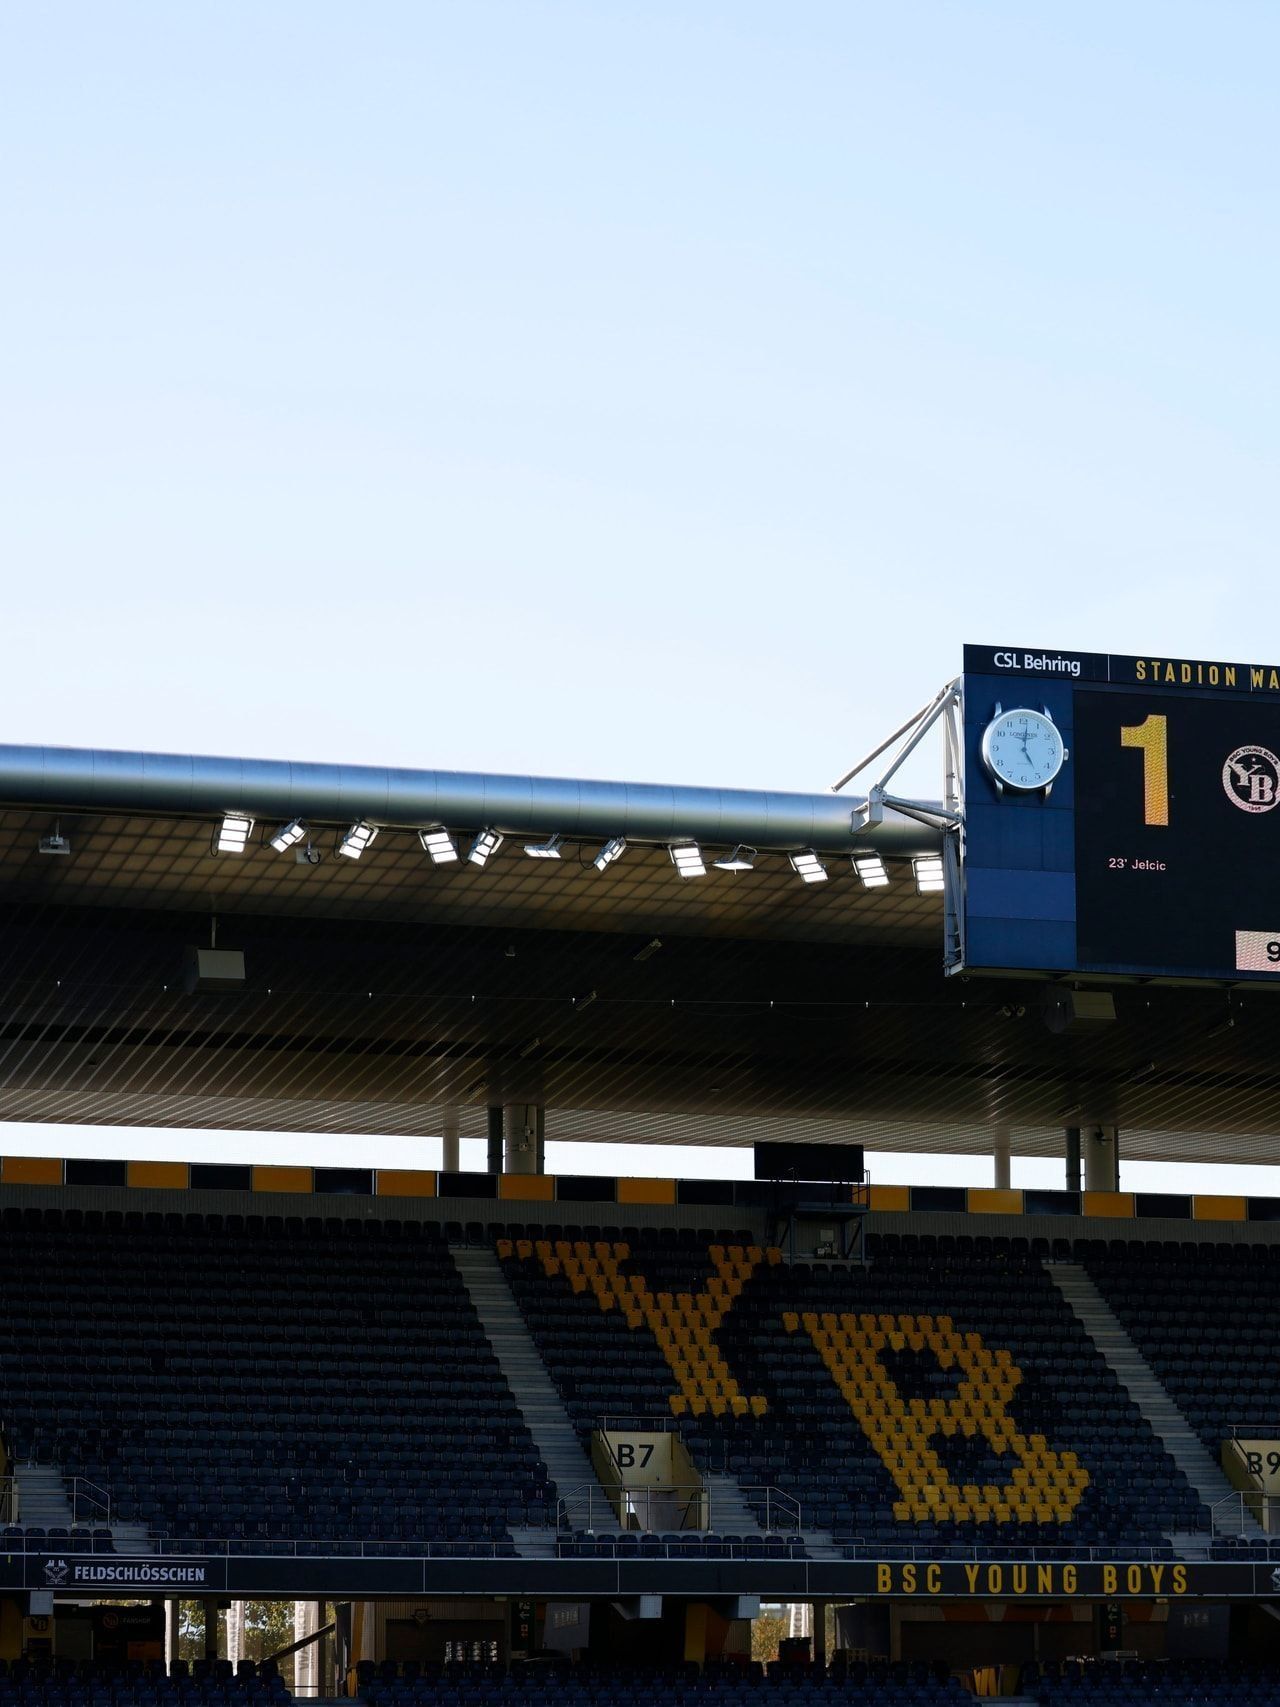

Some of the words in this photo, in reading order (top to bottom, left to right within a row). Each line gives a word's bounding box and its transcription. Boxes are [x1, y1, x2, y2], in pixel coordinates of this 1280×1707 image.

[994, 652, 1021, 669] CSL
[1024, 654, 1080, 677] Behring
[1136, 660, 1236, 687] STADION
[1121, 714, 1169, 826] 1
[1228, 762, 1274, 803] YB
[1108, 857, 1128, 869] 23'
[1131, 859, 1167, 871] Jelcic
[617, 1443, 654, 1468] B7
[1247, 1451, 1280, 1475] B9
[74, 1564, 205, 1581] FELDSCHLÖSSCHEN
[877, 1563, 941, 1594] BSC
[964, 1564, 1077, 1594] YOUNG
[1103, 1564, 1187, 1594] BOYS
